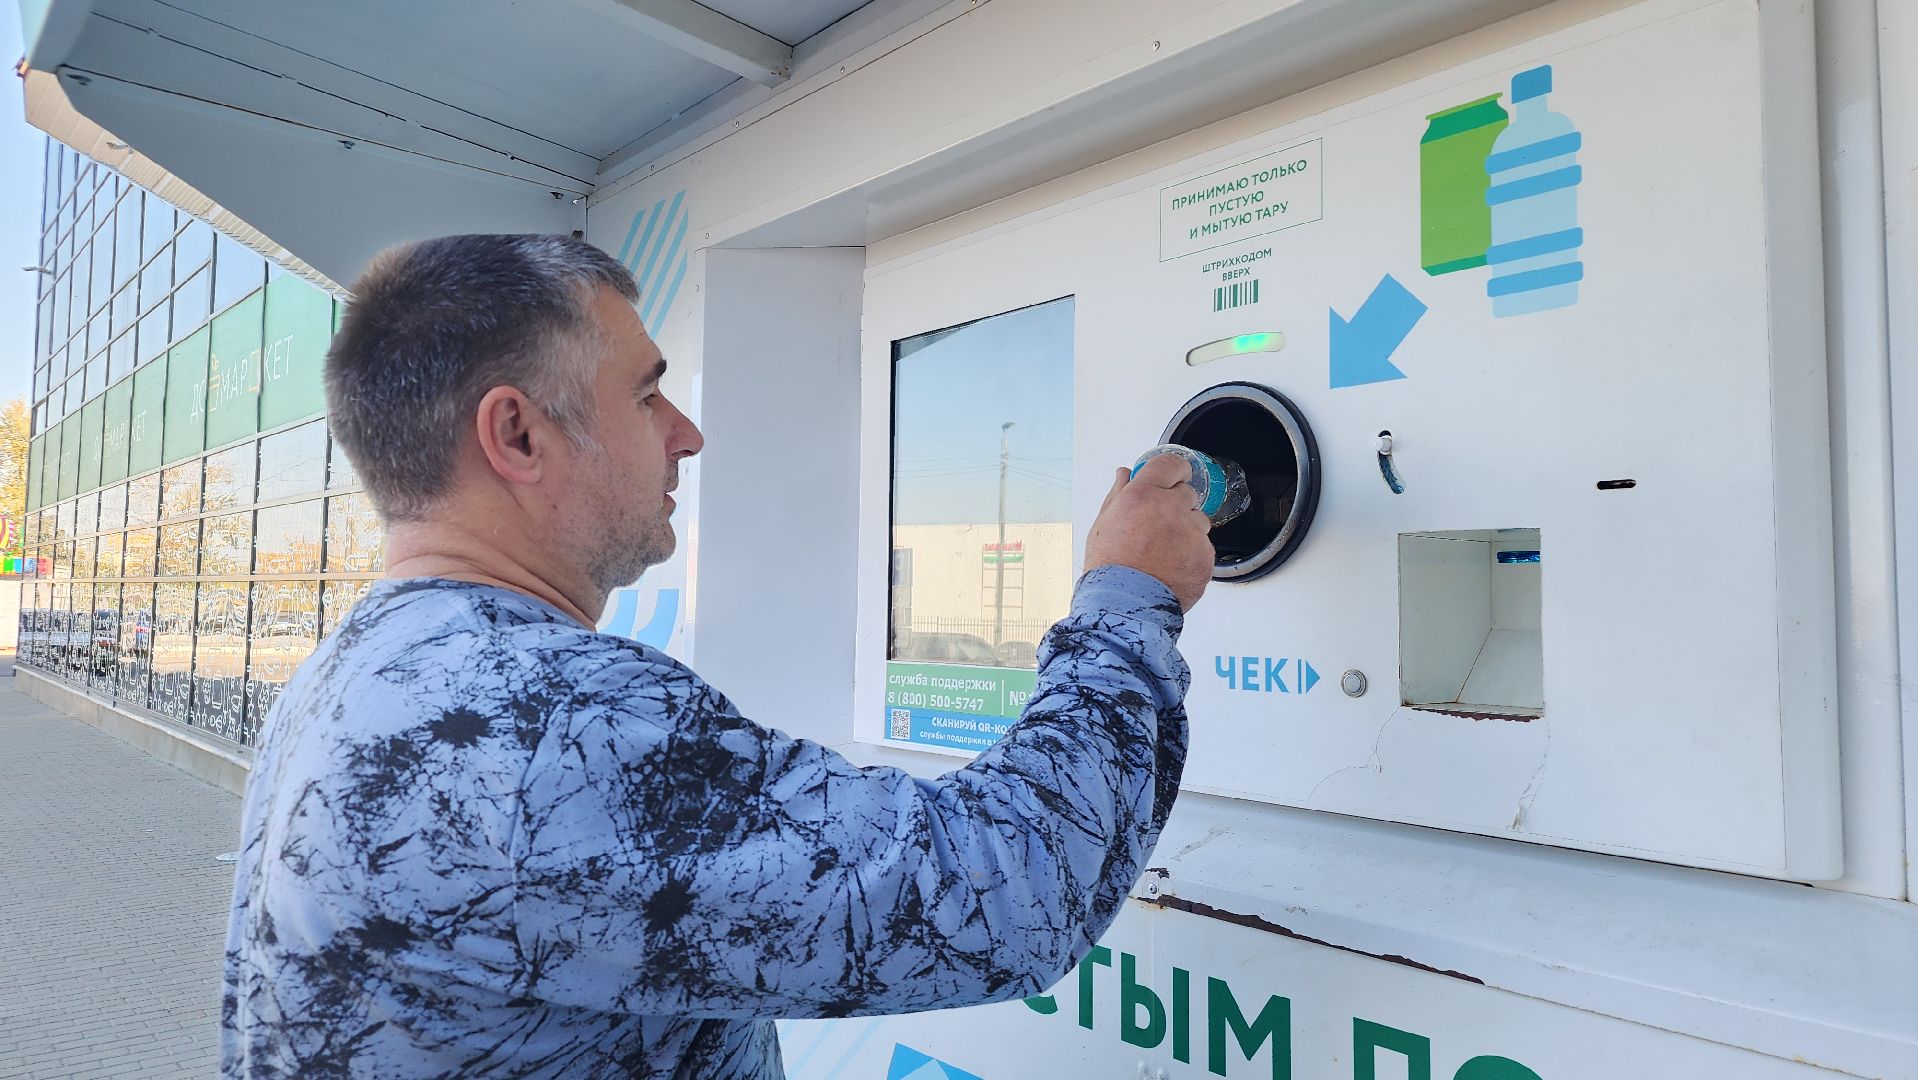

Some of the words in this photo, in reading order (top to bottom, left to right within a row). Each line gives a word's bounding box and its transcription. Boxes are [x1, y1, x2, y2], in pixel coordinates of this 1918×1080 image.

[1172, 177, 1248, 210] ПРИНИМАЮ
[1251, 159, 1307, 185] ТОЛЬКО
[1209, 190, 1265, 217] ПУСТУЮ
[1189, 228, 1198, 240] И
[1202, 212, 1252, 236] МЫТУЮ
[1255, 201, 1288, 221] ТАРУ
[1202, 248, 1272, 273] ШТРИХКОДОМ
[1222, 267, 1251, 282] ВВЕРХ
[889, 673, 928, 687] служба
[931, 677, 996, 693] поддержки
[1215, 655, 1291, 693] ЧЕК
[888, 691, 895, 704] 8
[898, 692, 926, 709] (800)
[930, 694, 984, 712] 500-5747
[932, 716, 977, 731] СКАНИРУЙ
[978, 722, 1013, 735] QR-КО
[920, 731, 945, 741] службы
[946, 734, 986, 746] поддержки
[1022, 944, 1291, 1080] ТЫМ
